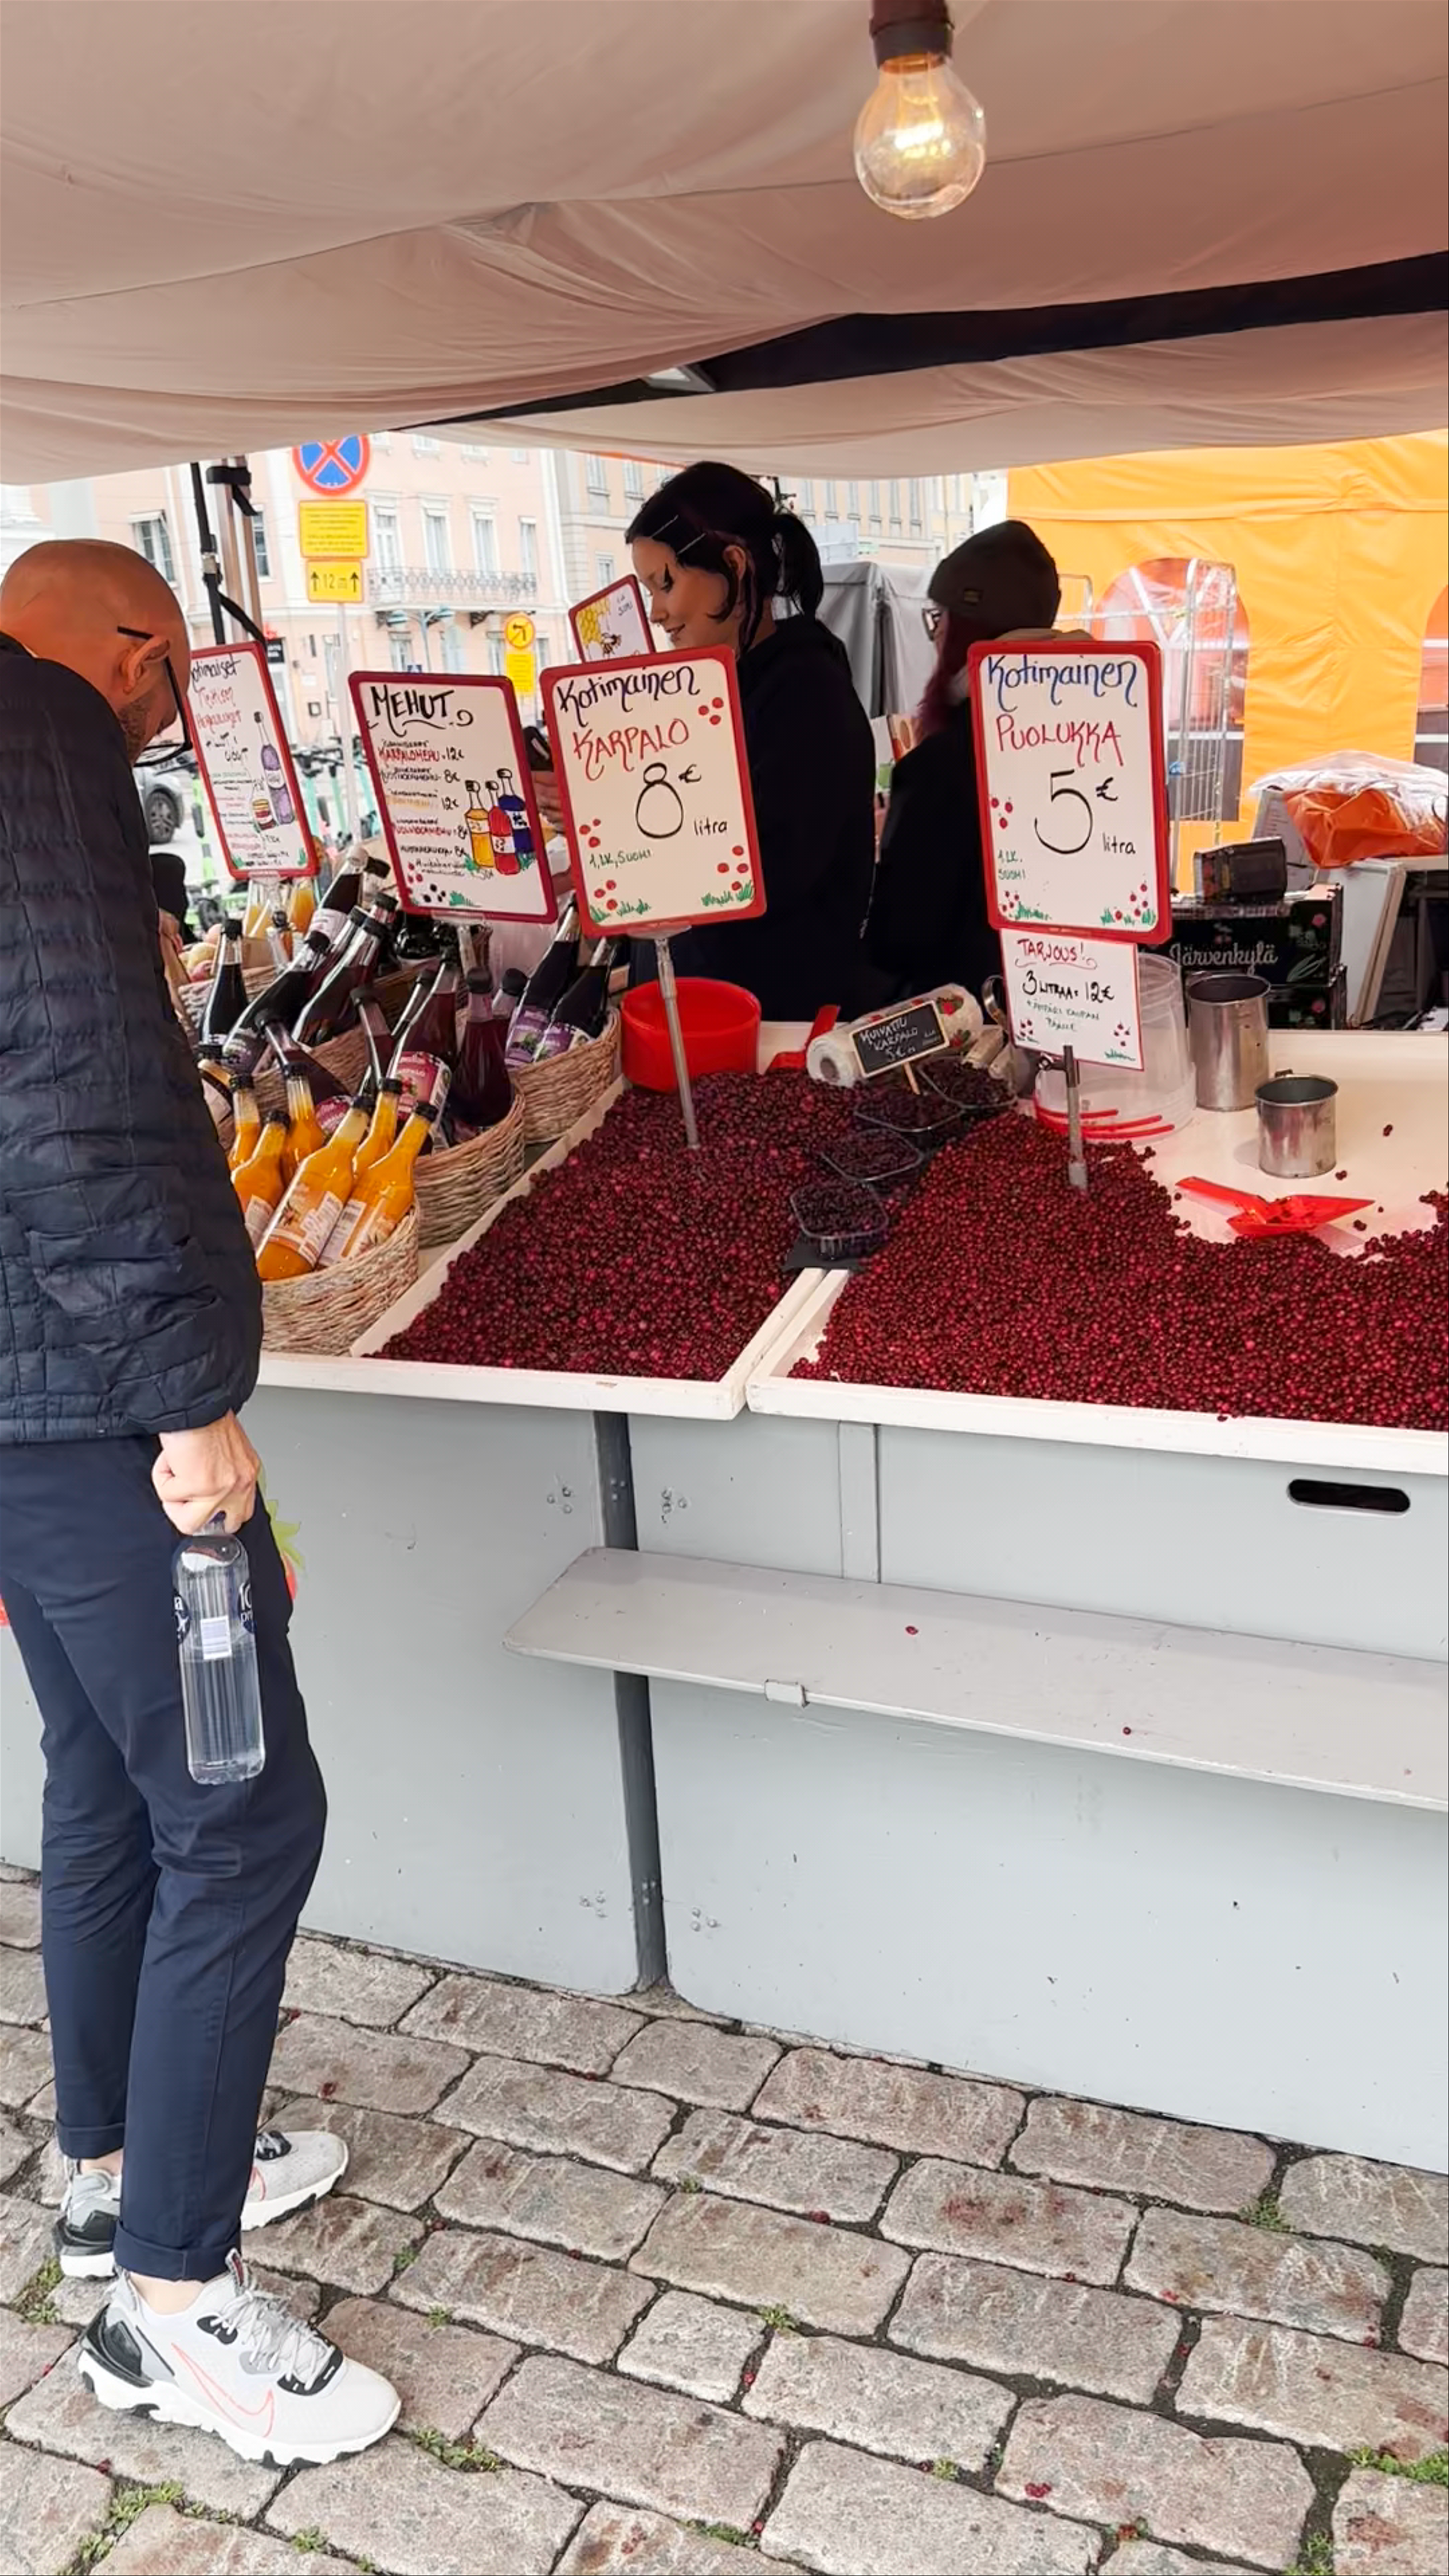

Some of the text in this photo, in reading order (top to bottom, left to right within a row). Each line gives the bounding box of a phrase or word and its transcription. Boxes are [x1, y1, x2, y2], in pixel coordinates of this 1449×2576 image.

[323, 573, 335, 589] 12
[191, 653, 242, 693] otimaiset
[988, 654, 1137, 712] Kotimainen
[371, 684, 455, 737] MEHUT
[556, 666, 701, 727] Kotimainen
[573, 718, 689, 781] KARPALO
[996, 714, 1124, 767] PUOLUKKA
[694, 817, 728, 836] litra
[1102, 832, 1136, 854] litra
[1017, 938, 1086, 962] TARJOUS!
[1169, 941, 1278, 976] Järvenkylä
[1085, 981, 1115, 1003] 12€
